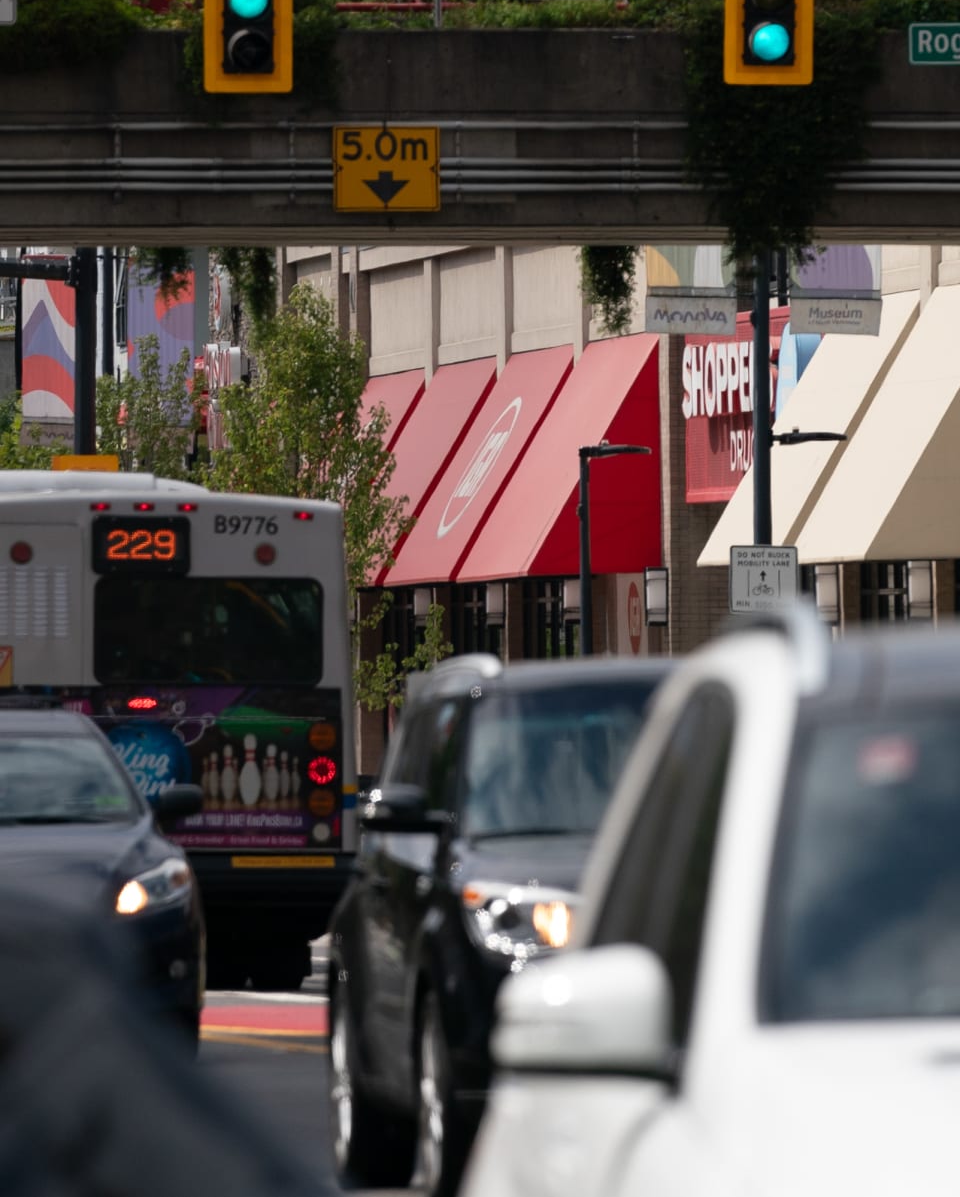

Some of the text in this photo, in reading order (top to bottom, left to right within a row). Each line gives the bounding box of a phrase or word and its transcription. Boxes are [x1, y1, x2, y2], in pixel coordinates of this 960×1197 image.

[342, 131, 428, 161] 5.0m
[809, 307, 863, 320] Museum
[682, 341, 774, 419] SHOPPE
[730, 429, 755, 471] DRU
[214, 515, 279, 535] B9776
[107, 529, 176, 560] 229
